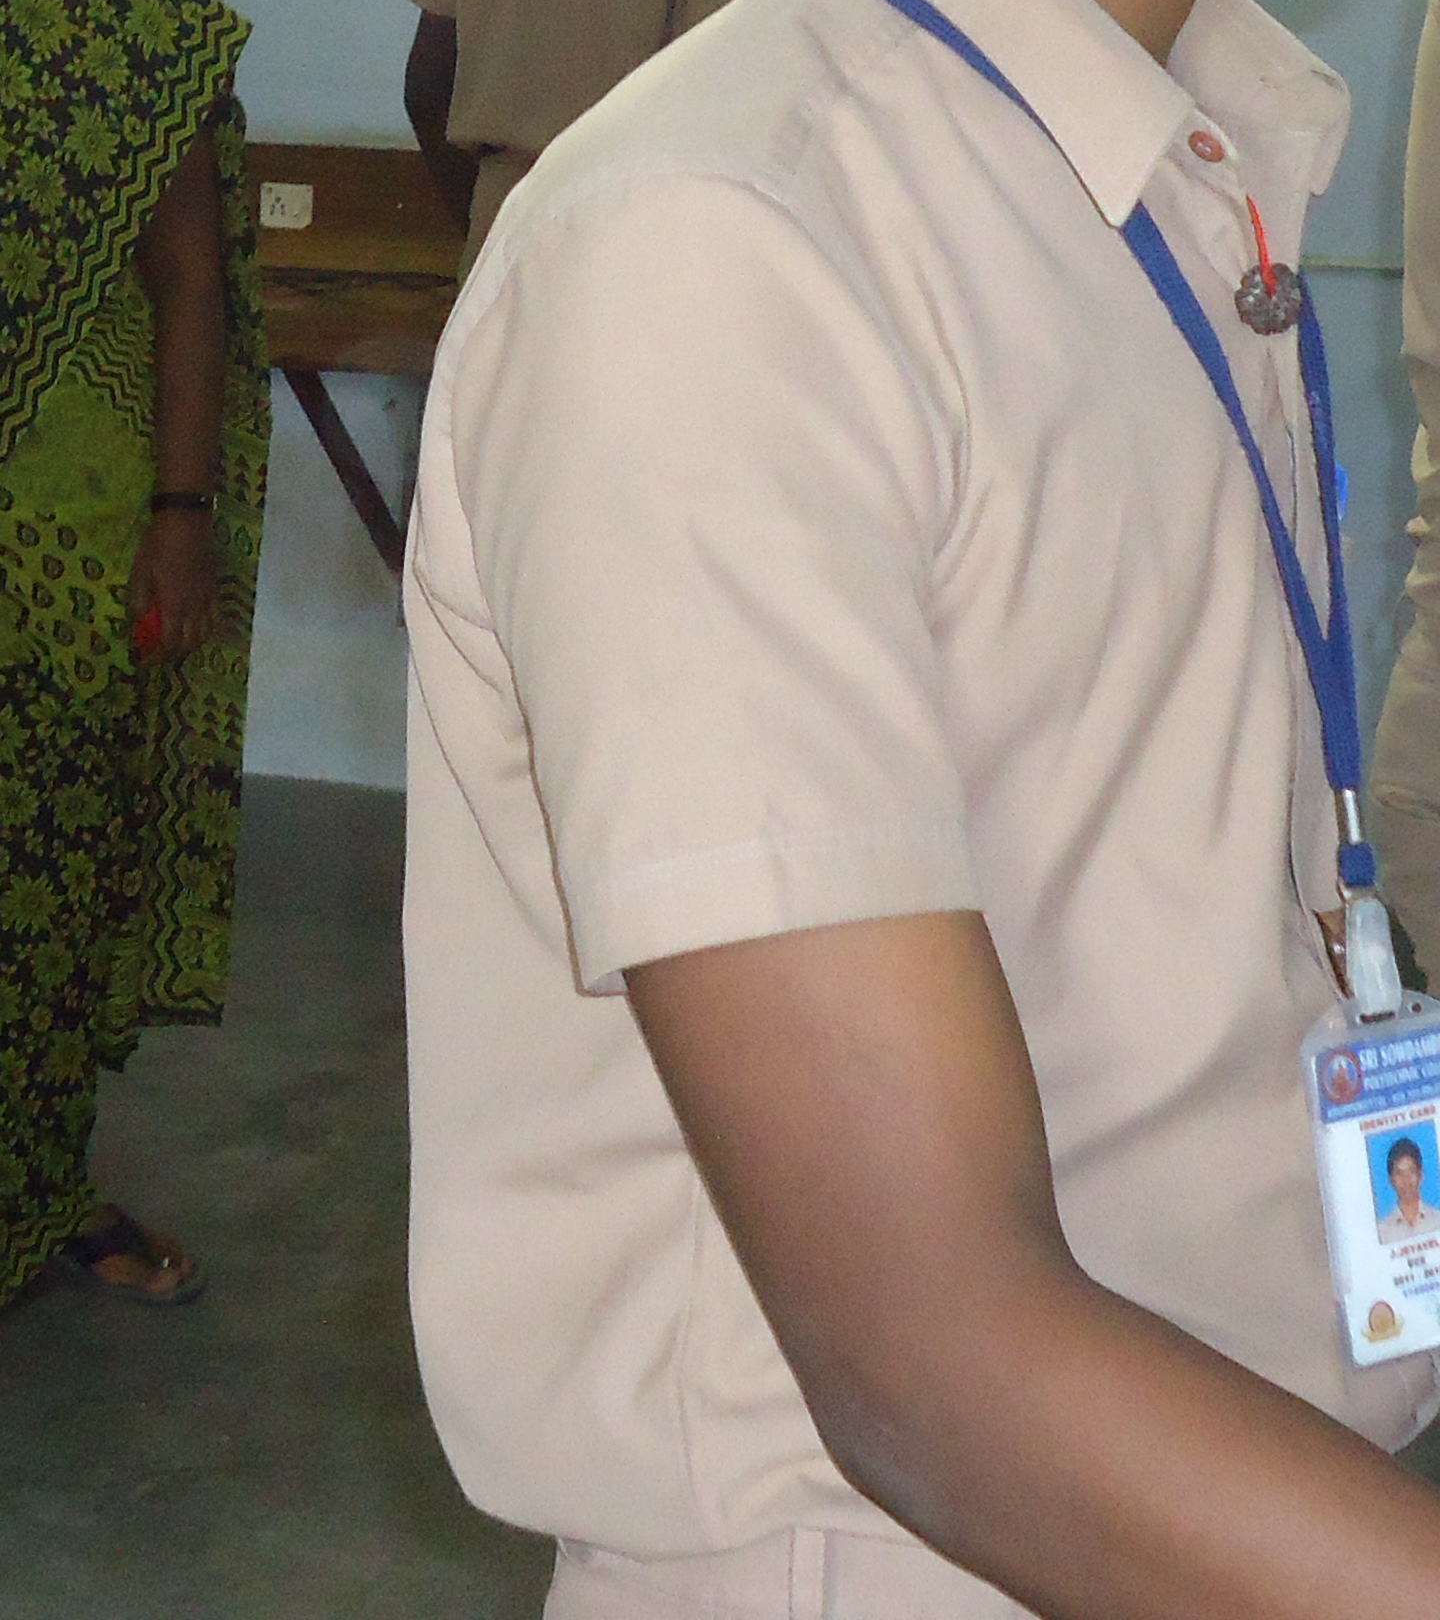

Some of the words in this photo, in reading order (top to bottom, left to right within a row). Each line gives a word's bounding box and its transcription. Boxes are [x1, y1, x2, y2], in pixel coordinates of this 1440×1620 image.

[1359, 1047, 1379, 1071] SRI
[1360, 1112, 1407, 1131] IDENTITY
[1409, 1105, 1436, 1120] CARD
